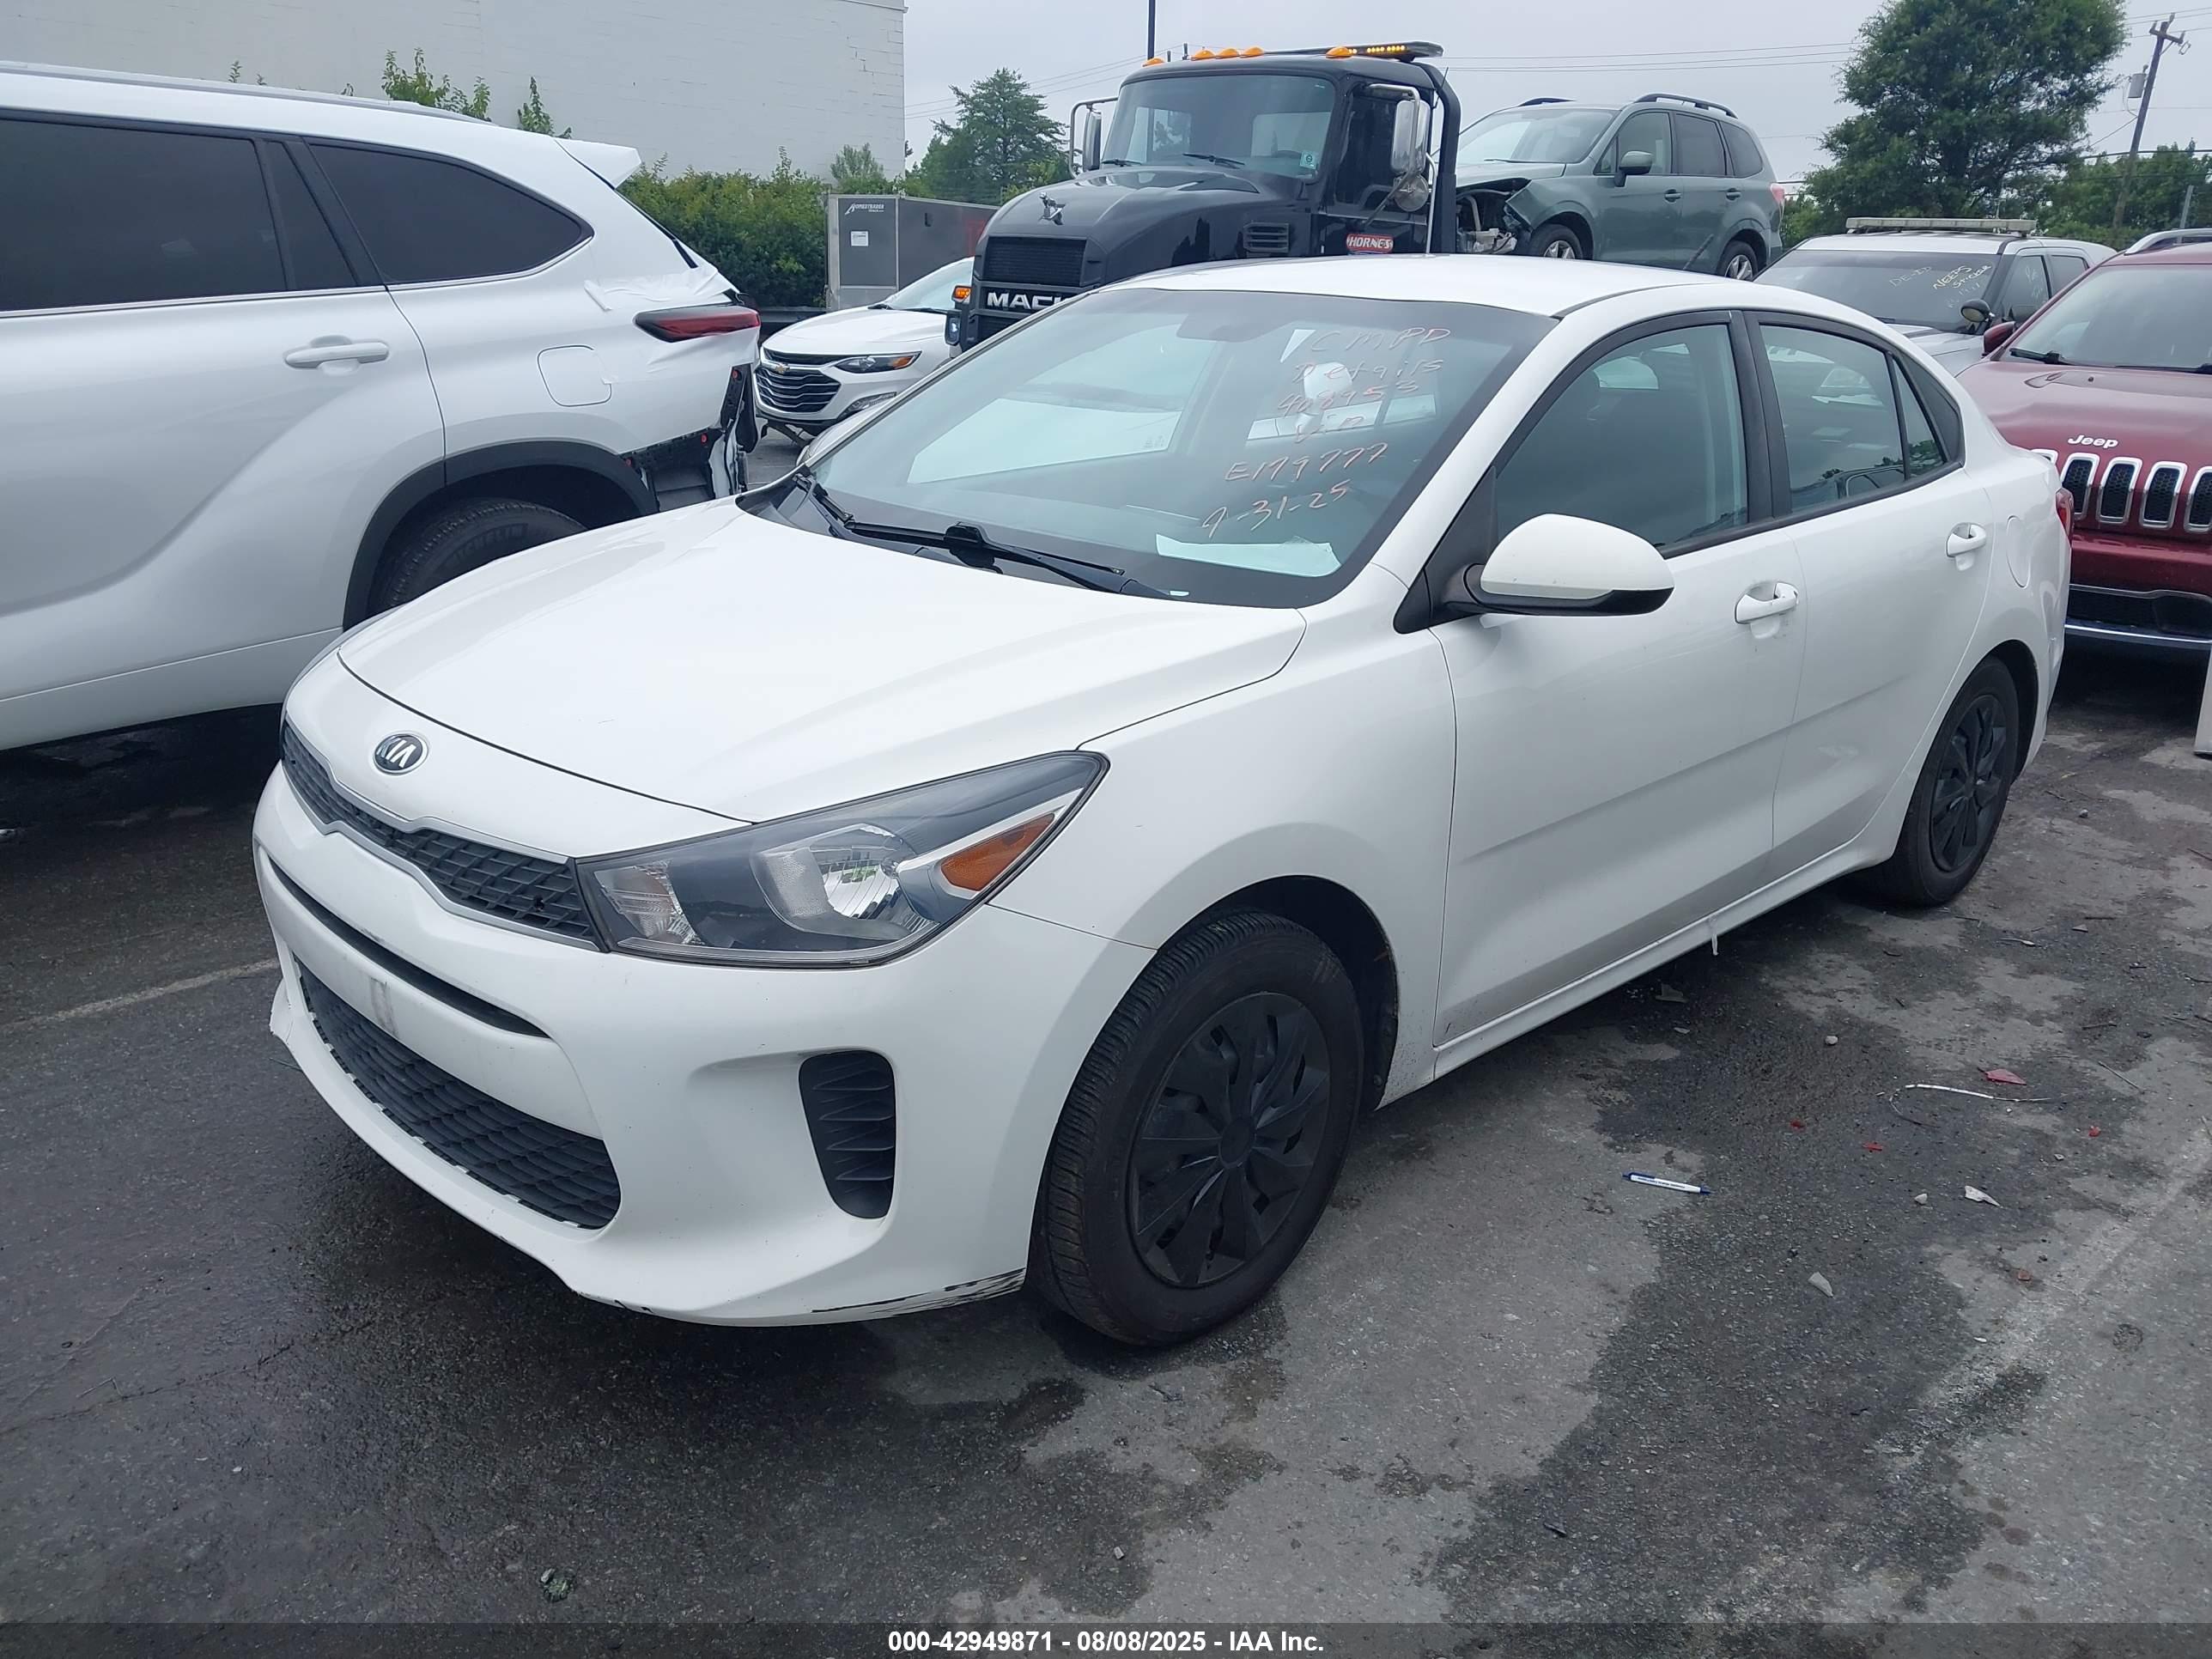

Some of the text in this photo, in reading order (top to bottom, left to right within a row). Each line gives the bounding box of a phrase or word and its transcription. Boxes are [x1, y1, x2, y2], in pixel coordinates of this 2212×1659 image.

[987, 292, 1061, 310] MAC
[2067, 434, 2119, 449] Jeep
[376, 738, 417, 769] KIA
